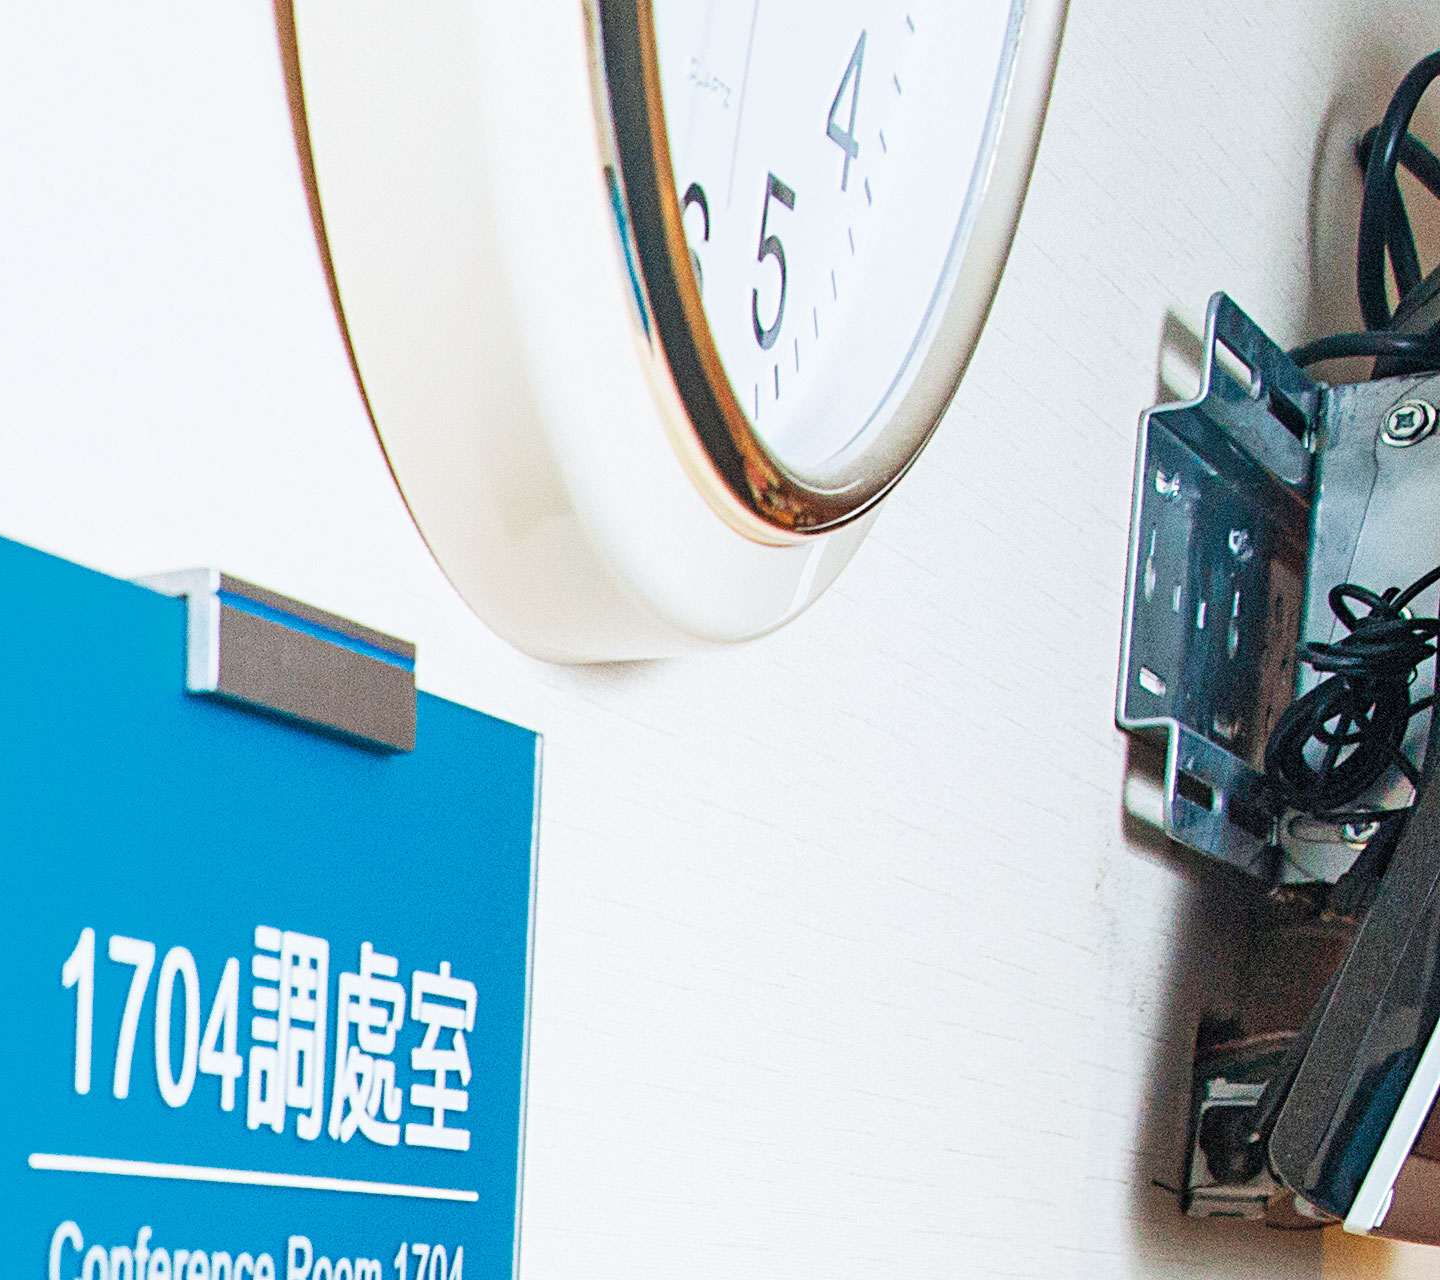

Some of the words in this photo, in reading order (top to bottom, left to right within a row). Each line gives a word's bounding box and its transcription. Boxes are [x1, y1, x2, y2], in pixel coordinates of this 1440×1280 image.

[826, 29, 867, 192] 4
[752, 170, 796, 350] 5
[60, 925, 480, 1152] 1704調處室
